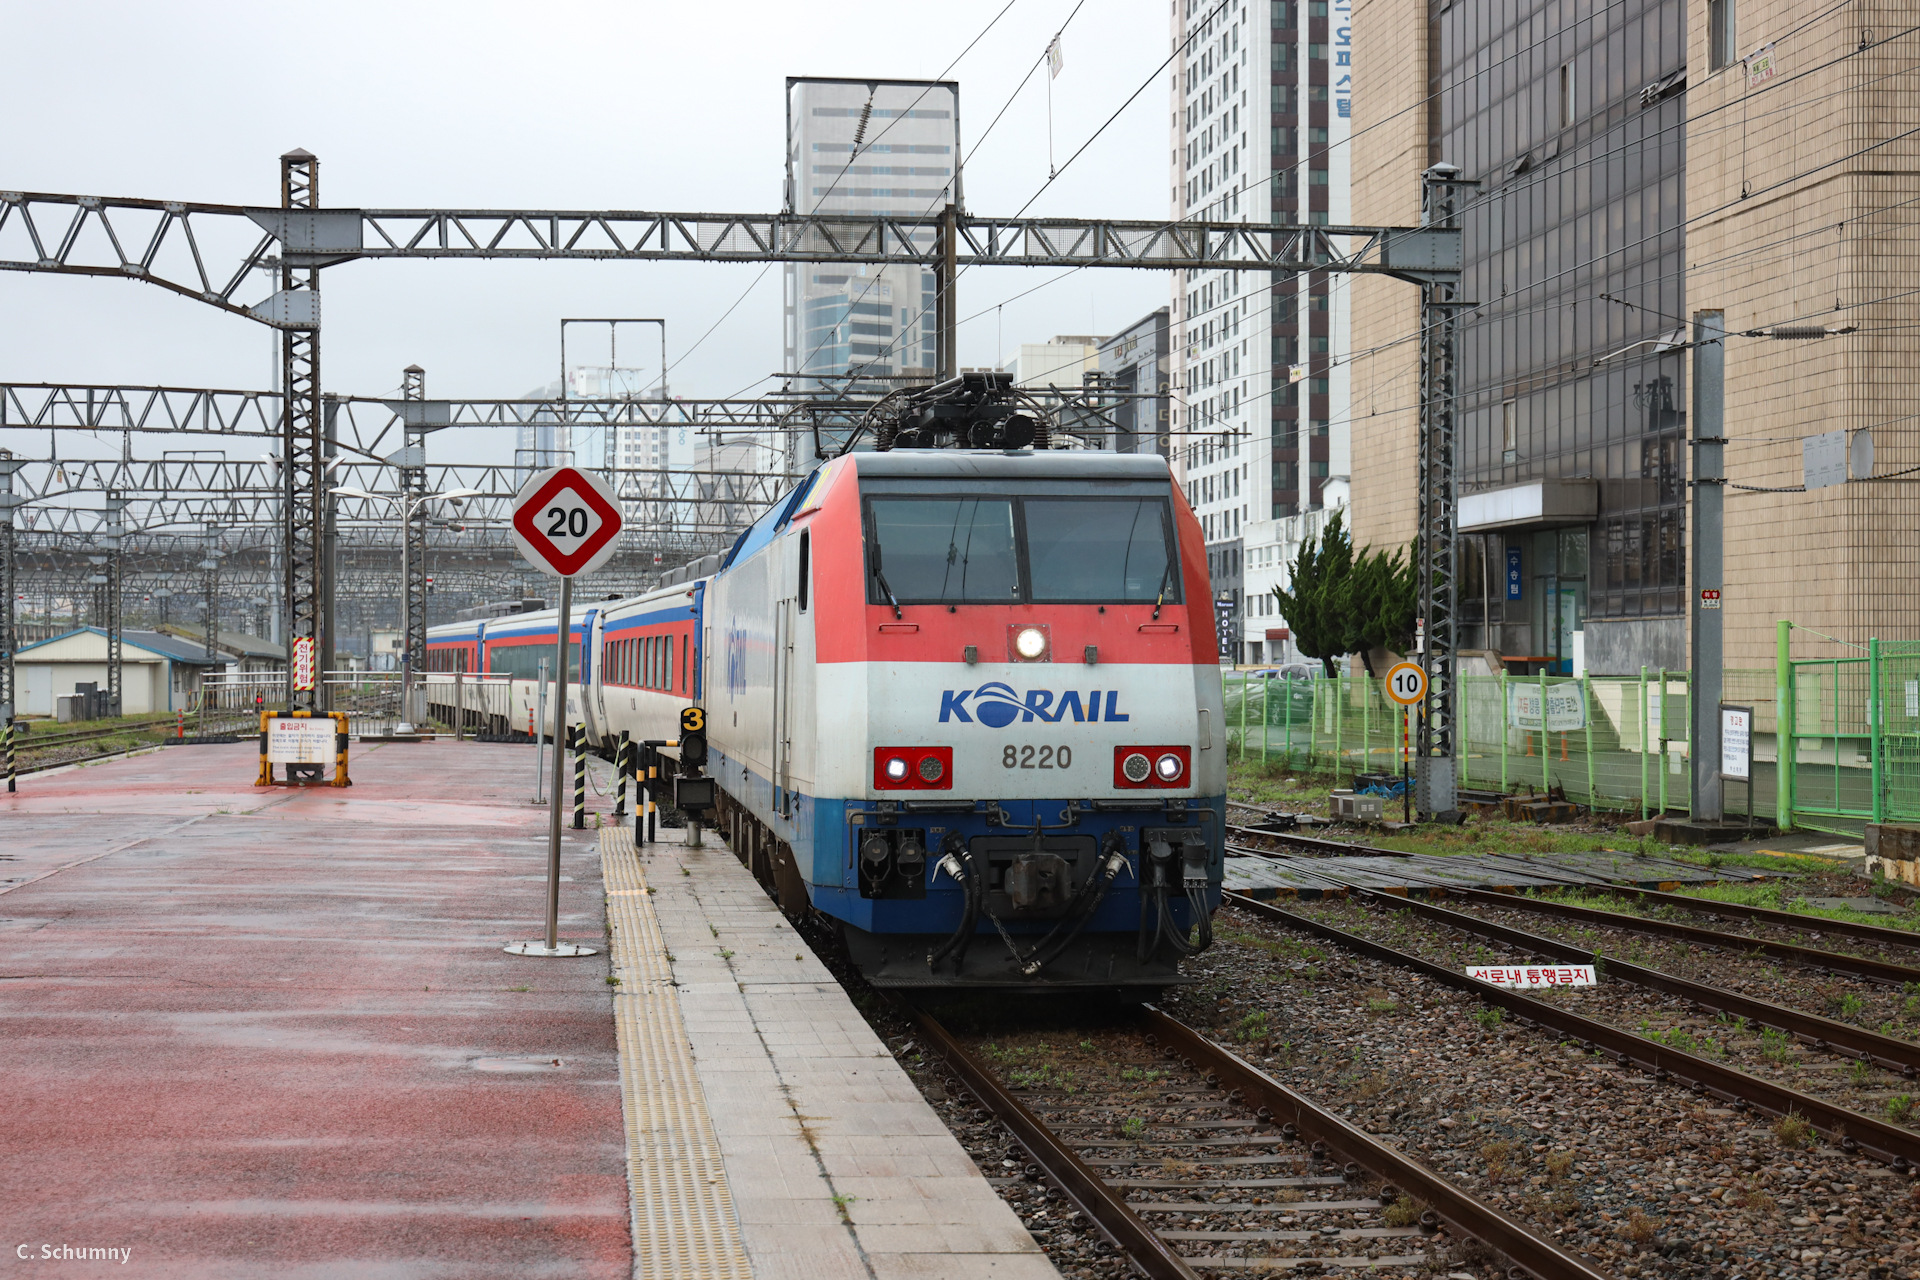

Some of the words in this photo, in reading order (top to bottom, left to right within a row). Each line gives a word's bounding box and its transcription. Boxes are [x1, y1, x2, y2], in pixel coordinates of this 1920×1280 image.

[548, 507, 588, 538] 20
[298, 644, 308, 684] 전기위험
[1396, 674, 1418, 692] 10
[938, 682, 1130, 728] KORAIL
[280, 722, 308, 730] 출입금지
[684, 708, 704, 731] 3
[1002, 744, 1072, 769] 8220
[1526, 968, 1589, 984] 통행금지
